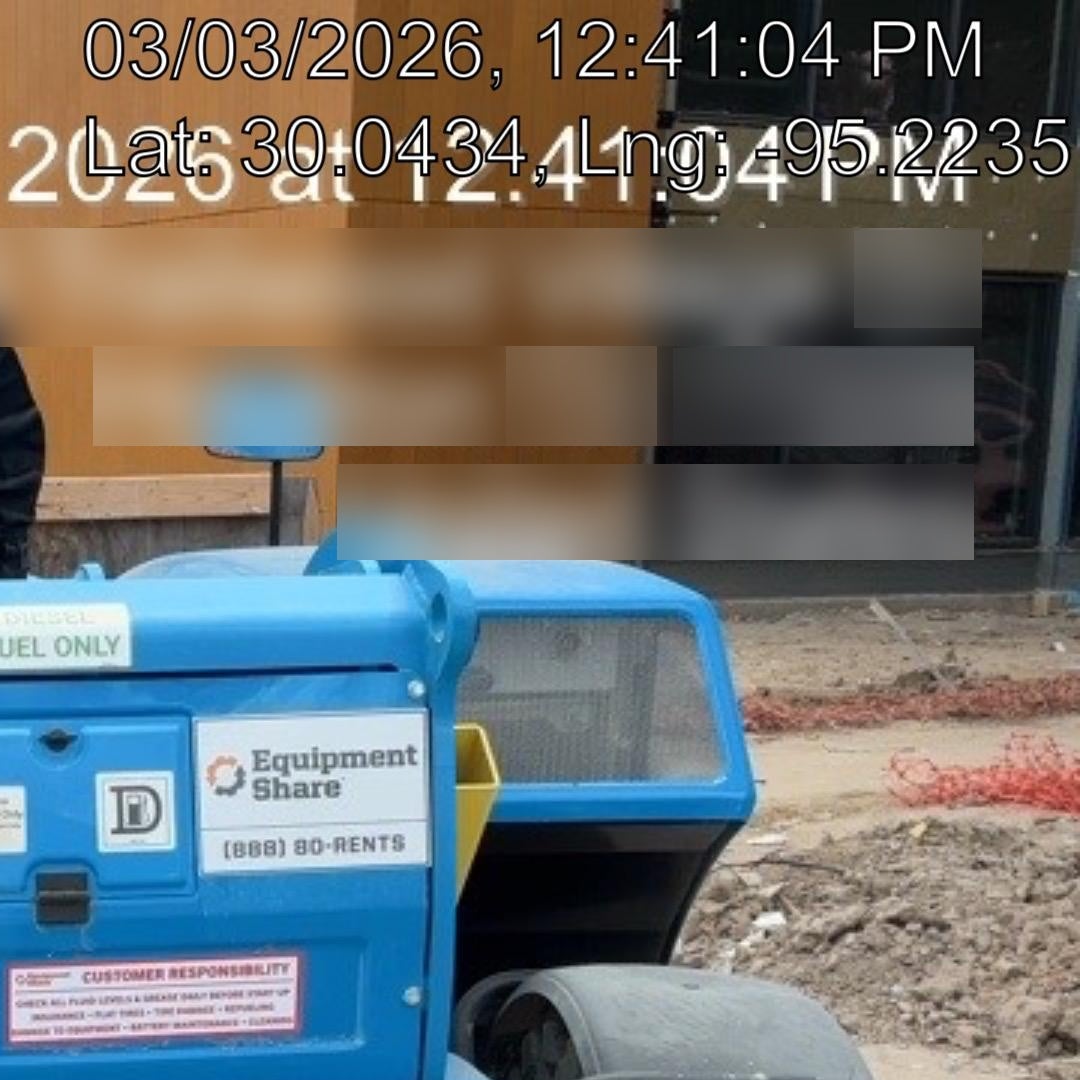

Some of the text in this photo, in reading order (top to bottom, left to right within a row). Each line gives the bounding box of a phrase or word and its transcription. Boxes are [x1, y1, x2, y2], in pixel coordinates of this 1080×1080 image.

[3, 610, 96, 625] DIESEL
[53, 633, 121, 658] ONLY
[251, 744, 418, 775] Equipment
[251, 776, 343, 801] Share
[224, 834, 406, 859] (888) 80-RENTS
[82, 963, 291, 984] CUSTOMER RESPONSIBILITY
